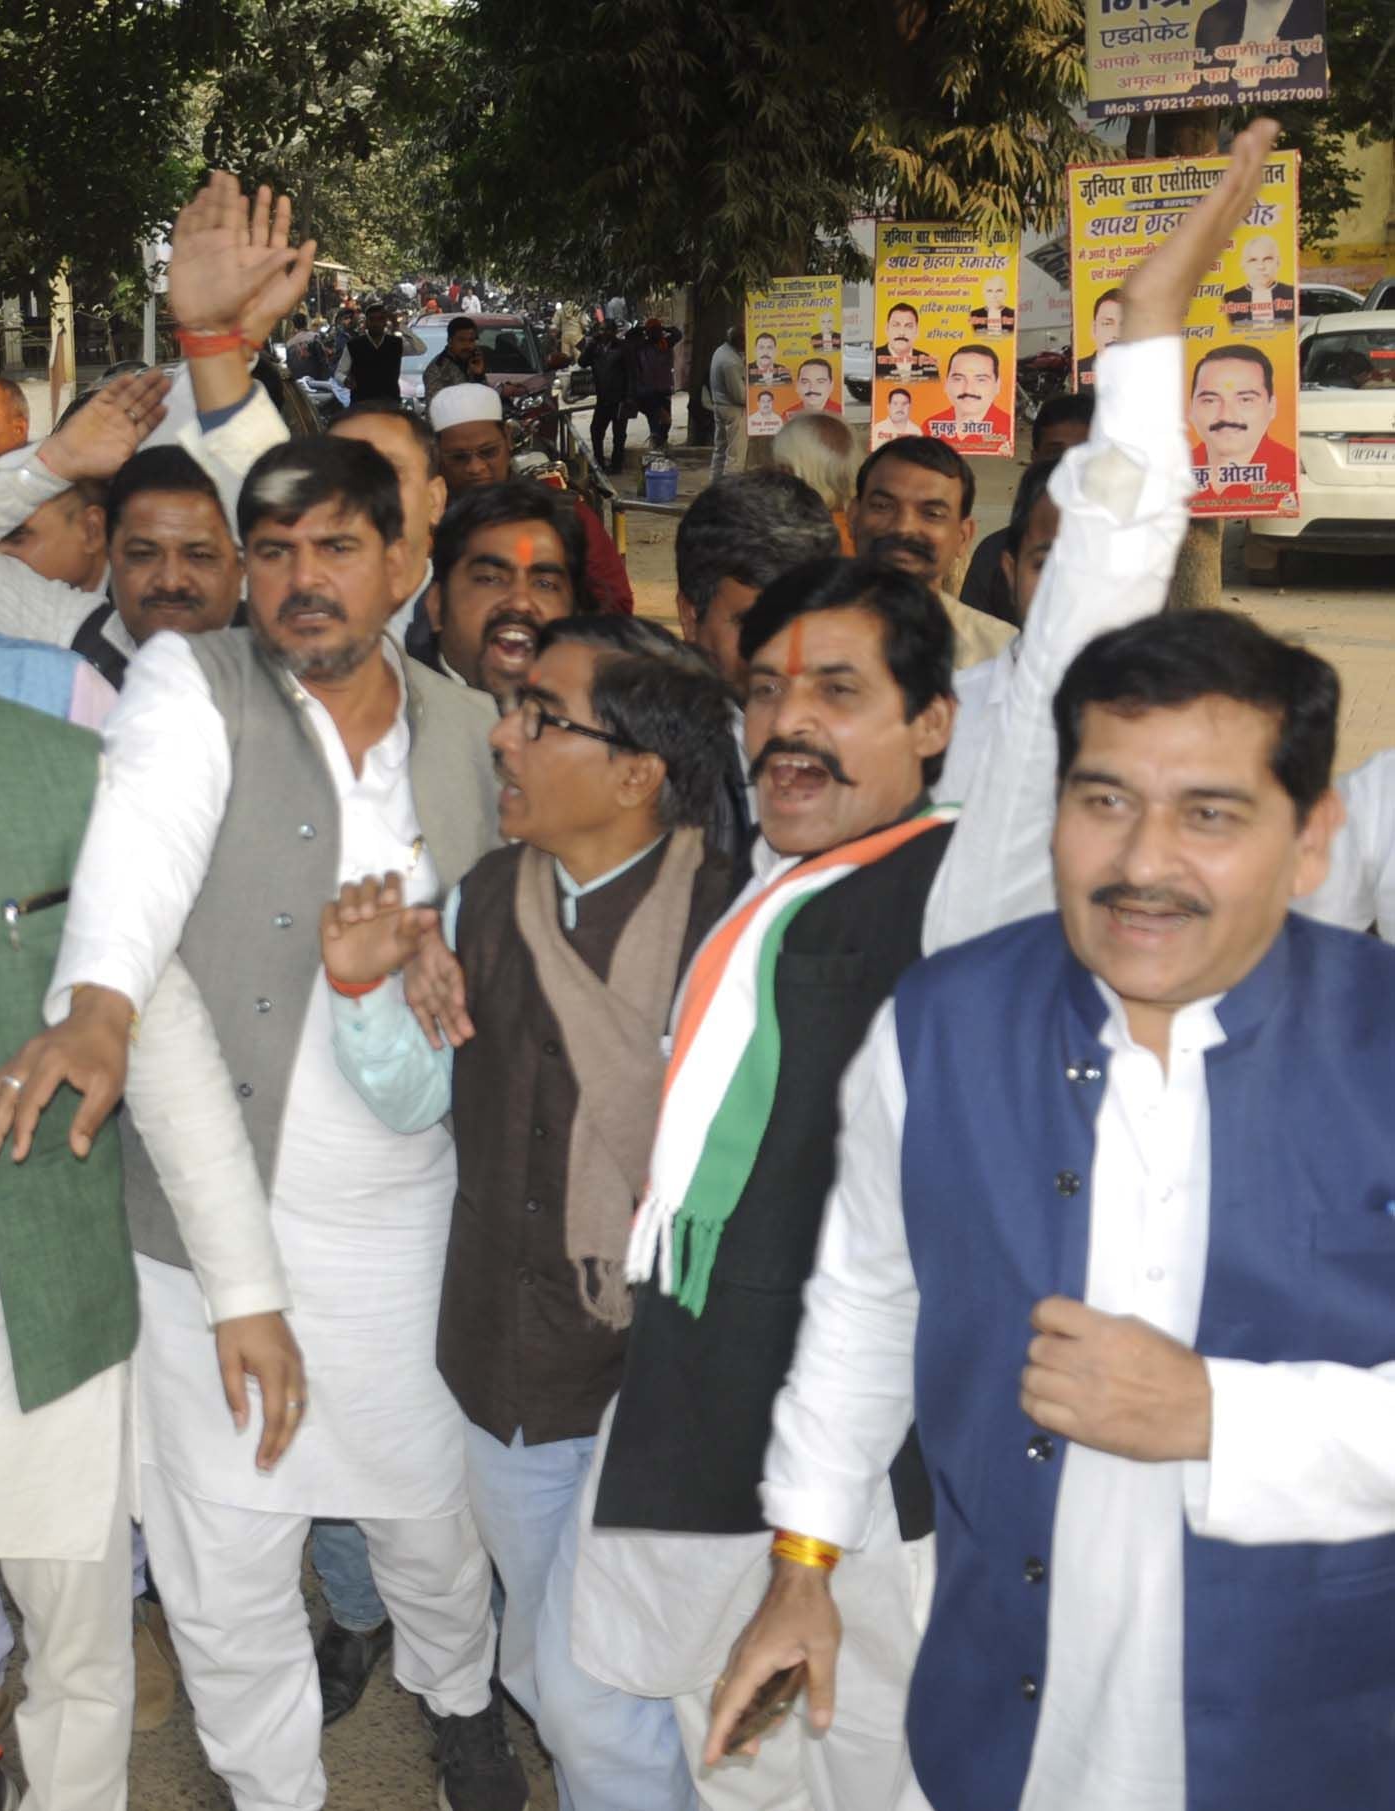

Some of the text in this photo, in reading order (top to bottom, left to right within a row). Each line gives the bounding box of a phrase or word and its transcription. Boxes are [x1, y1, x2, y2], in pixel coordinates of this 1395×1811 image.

[1099, 17, 1189, 48] एडवोकेट
[1094, 52, 1139, 70] आपके
[1117, 74, 1165, 90] अमूल्य
[1105, 102, 1140, 115] Mob:
[1237, 88, 1323, 103] 9118927000
[1080, 173, 1125, 206] जूनियर
[1131, 175, 1153, 194] बार
[1158, 166, 1225, 192] एसोसिएश
[1090, 217, 1138, 236] शपथ
[883, 228, 912, 248] जूनियर
[916, 230, 930, 243] बार
[888, 252, 1007, 270] शपथ ग्रहण समारोह
[1219, 462, 1265, 483] ओझा
